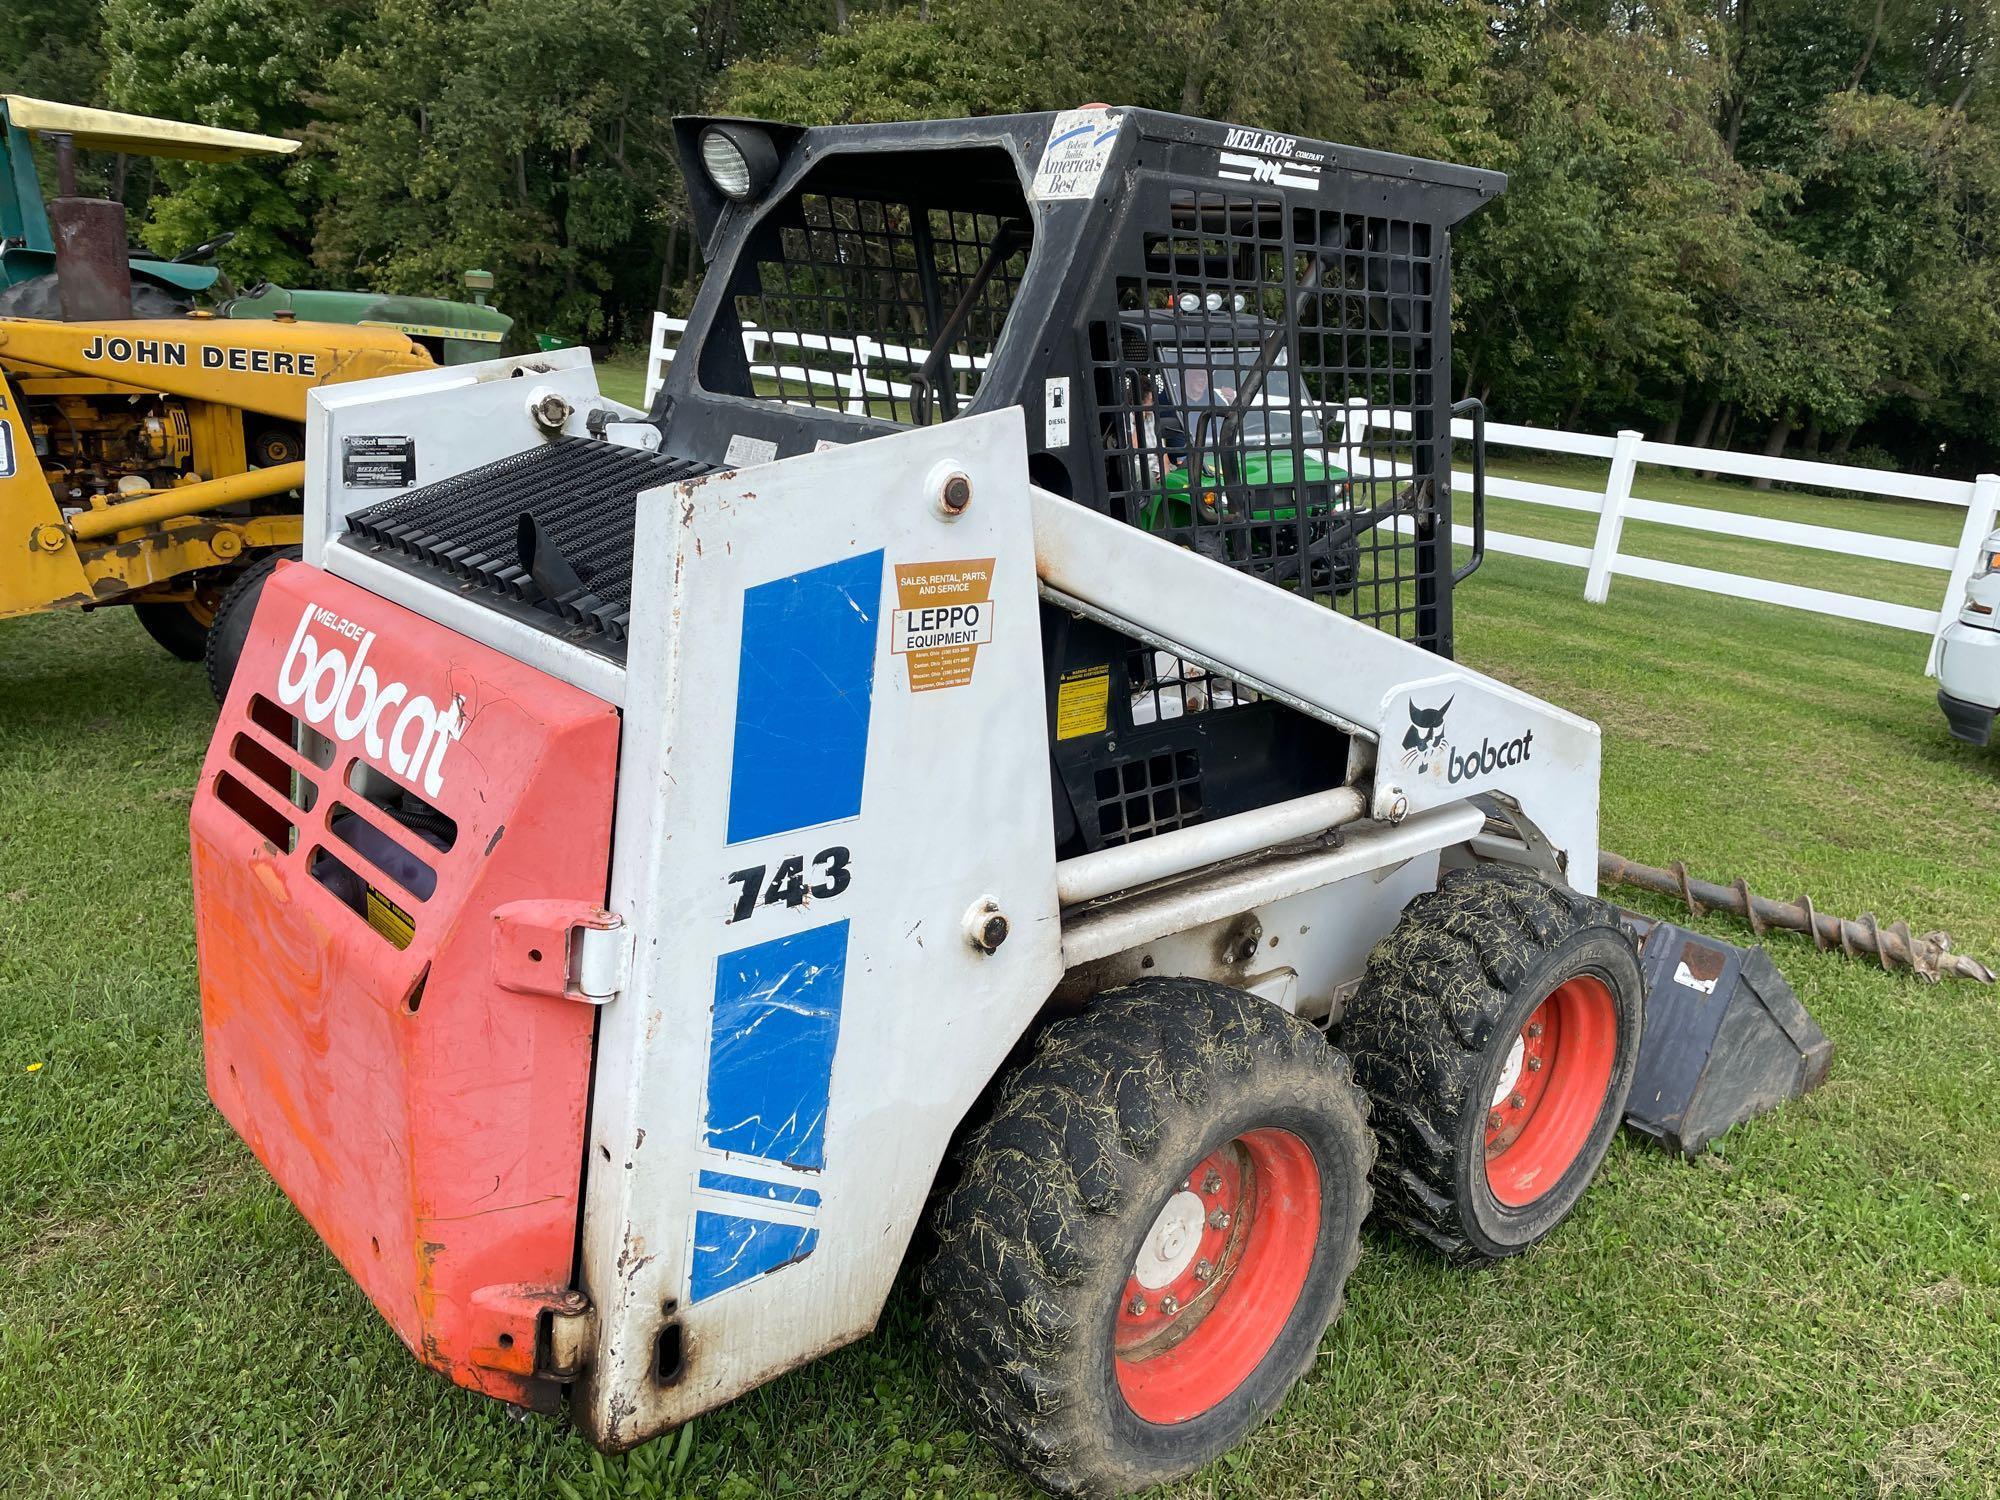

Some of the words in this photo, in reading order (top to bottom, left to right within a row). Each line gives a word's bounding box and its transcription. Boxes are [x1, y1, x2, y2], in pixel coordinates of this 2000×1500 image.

[1223, 128, 1296, 157] MELROE
[1295, 150, 1325, 162] COMPANY
[1042, 156, 1103, 174] America's
[1048, 175, 1077, 194] Best
[83, 336, 187, 366] JOHN
[200, 345, 316, 377] DEERE
[1048, 418, 1067, 426] DIESEL
[900, 576, 928, 586] SALES,
[930, 573, 960, 584] RENTAL,
[919, 585, 937, 596] AND
[937, 583, 970, 594] SERVICE
[314, 607, 365, 642] MELROE
[907, 605, 979, 633] LEPPO
[907, 630, 978, 649] EQUIPMENT
[278, 602, 467, 798] bobcat
[1447, 729, 1533, 784] bobcat
[728, 846, 851, 923] 743
